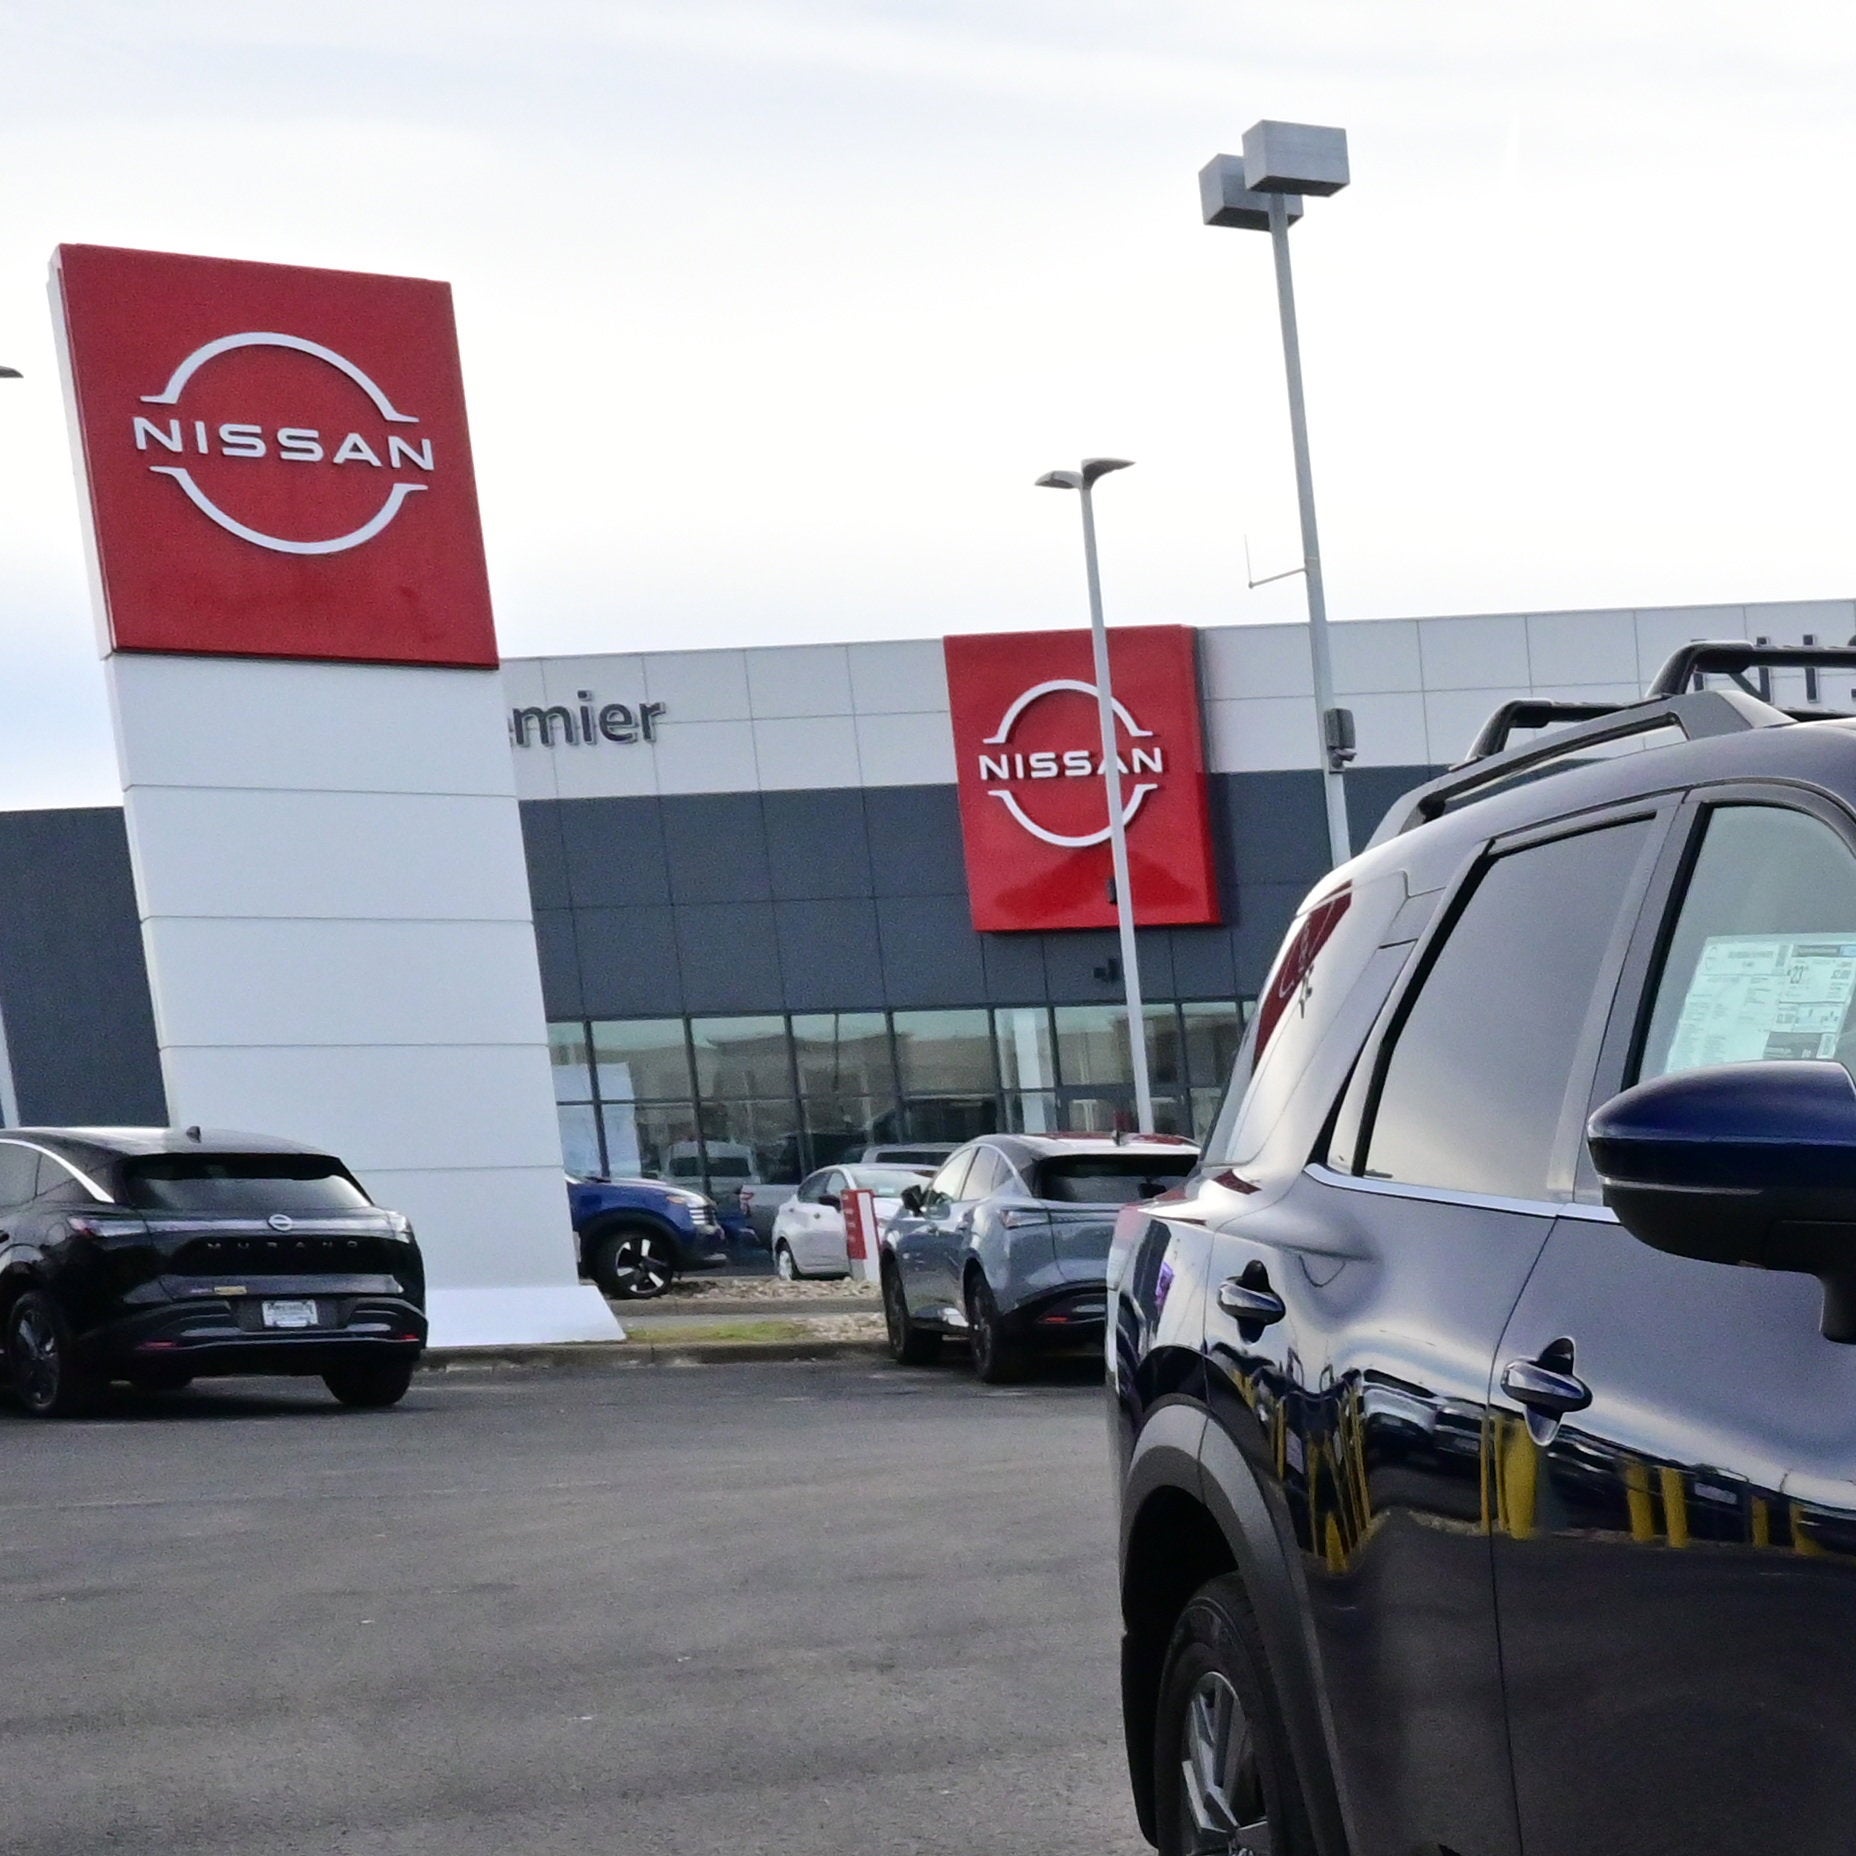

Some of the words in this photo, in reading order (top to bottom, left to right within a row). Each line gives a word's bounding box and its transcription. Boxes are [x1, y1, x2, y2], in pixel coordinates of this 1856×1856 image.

[133, 416, 434, 471] NISSAN
[508, 690, 666, 747] mier
[978, 747, 1163, 780] NISSAN
[207, 1240, 358, 1249] MURANO
